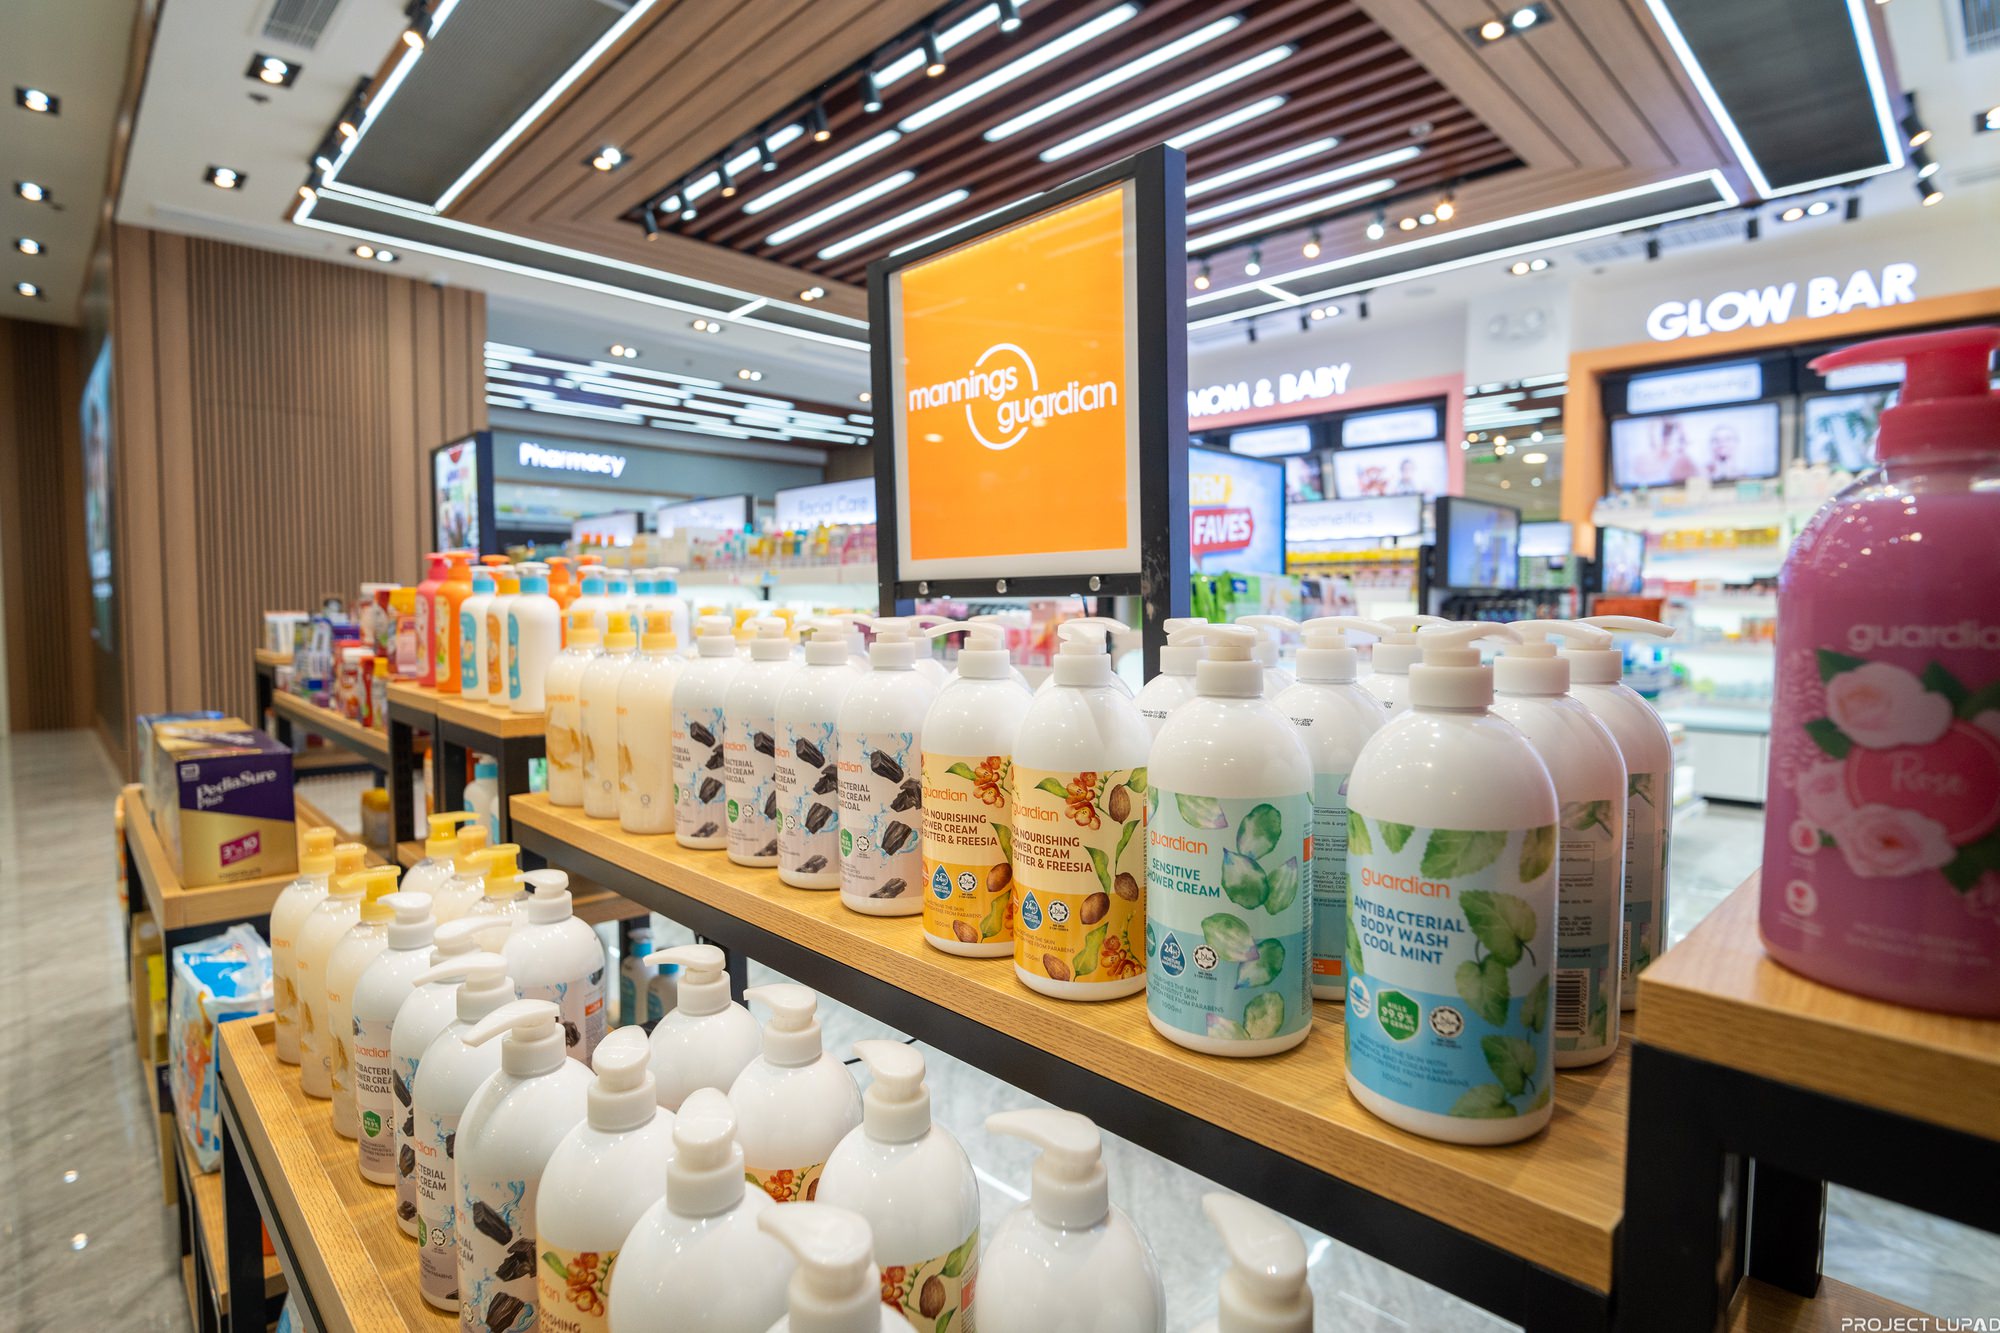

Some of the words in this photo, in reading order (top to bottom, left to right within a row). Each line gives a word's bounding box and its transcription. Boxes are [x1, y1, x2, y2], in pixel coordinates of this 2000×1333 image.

[1646, 282, 1797, 341] GLOW
[1807, 262, 1917, 318] BAR
[909, 366, 1018, 412] mannings
[1188, 382, 1250, 417] MOM
[1253, 379, 1274, 407] &
[1280, 363, 1351, 403] BABY
[997, 380, 1117, 433] guardian
[518, 441, 627, 478] Pharmacy
[1193, 513, 1250, 545] FAVES
[733, 767, 755, 776] CREAM
[197, 770, 277, 798] PediaSure
[846, 791, 871, 803] CREAM
[922, 786, 968, 802] guardian
[930, 809, 987, 824] NOURISHING
[944, 823, 978, 835] CREAM
[1019, 828, 1080, 847] NOURISHING
[948, 834, 955, 845] &
[956, 835, 998, 846] FREESIA
[1150, 830, 1208, 855] guardian
[1033, 845, 1070, 860] CREAM
[1037, 858, 1044, 869] &
[1046, 860, 1093, 873] FREESIA
[1152, 858, 1201, 881] SENSITIVE
[1176, 880, 1220, 898] CREAM
[1361, 867, 1451, 899] guardian
[1354, 895, 1465, 933] ANTIBACTERIAL
[1361, 914, 1394, 937] BODY
[1398, 926, 1449, 949] WASH
[1164, 942, 1173, 954] 24
[1363, 933, 1397, 956] COOL
[1400, 944, 1444, 965] MINT
[1174, 997, 1190, 1007] FROM
[1191, 1002, 1225, 1014] PARABENS
[1183, 992, 1198, 1001] SKIN
[1381, 1006, 1415, 1025] 99.9%
